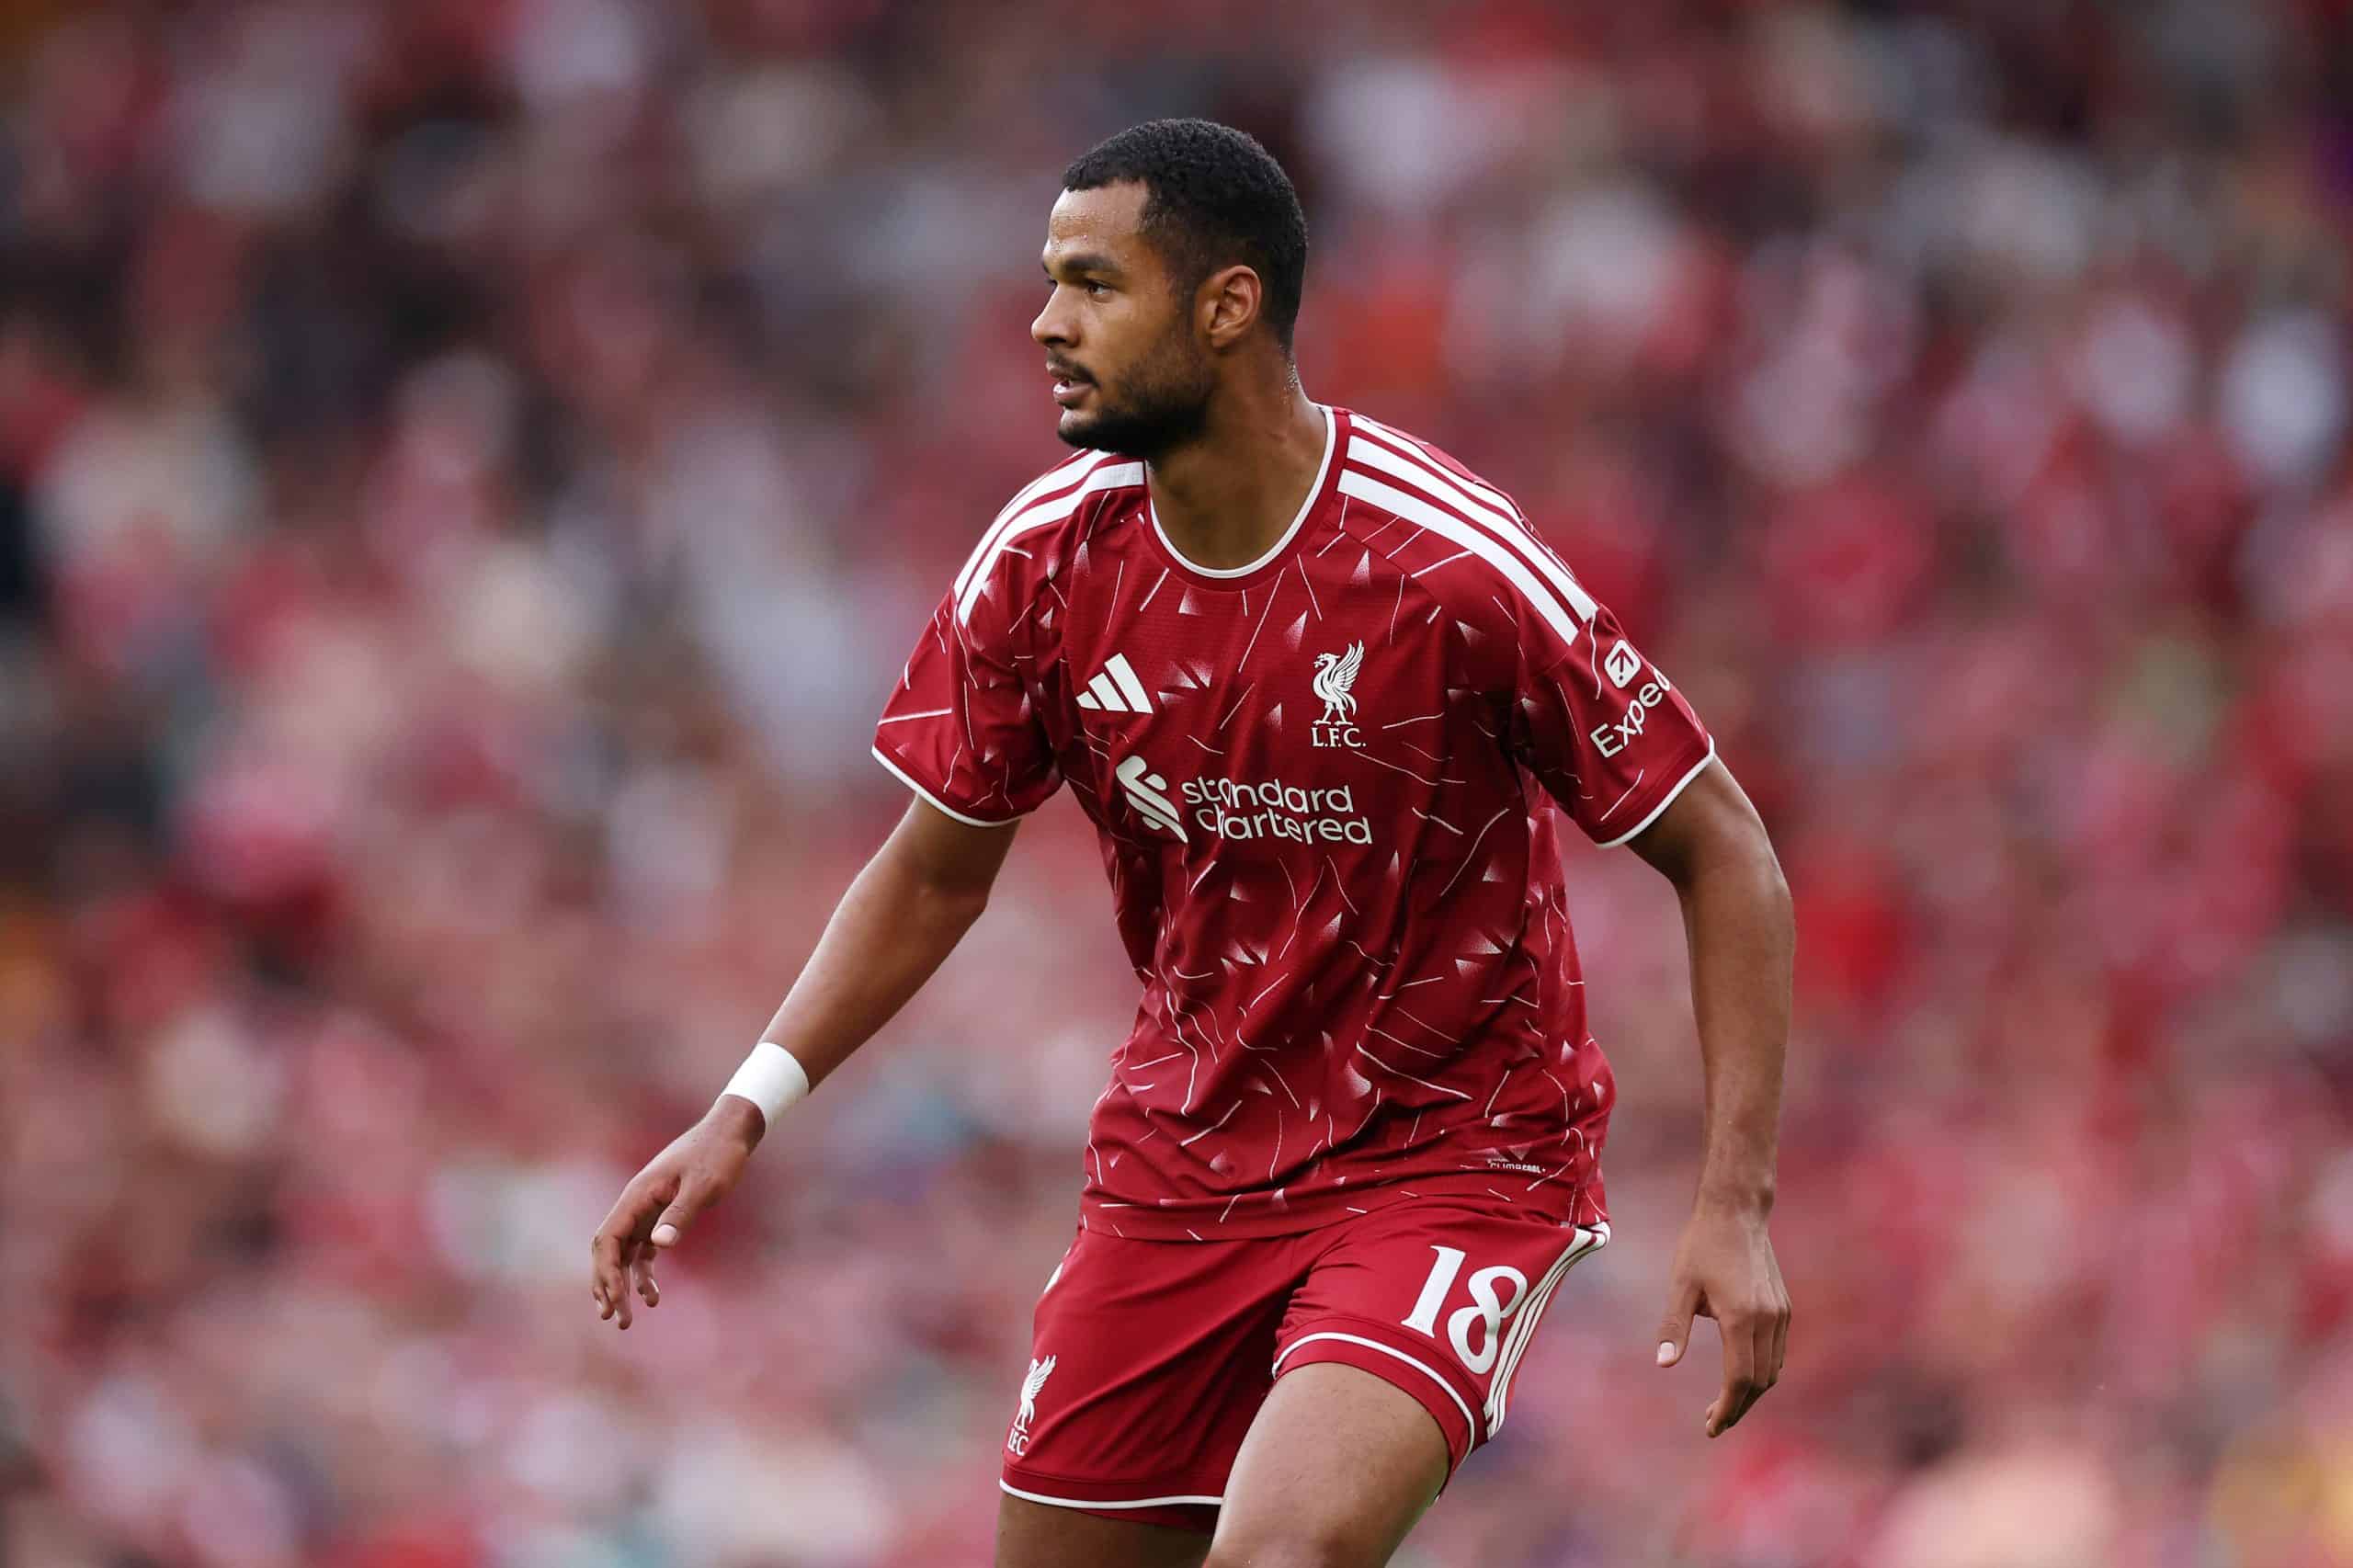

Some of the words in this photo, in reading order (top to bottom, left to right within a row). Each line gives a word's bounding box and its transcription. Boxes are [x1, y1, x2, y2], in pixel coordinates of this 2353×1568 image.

[1311, 727, 1367, 748] L.F.C.
[1181, 776, 1354, 813] standard
[1196, 802, 1372, 845] chartered
[1400, 1244, 1528, 1375] 18
